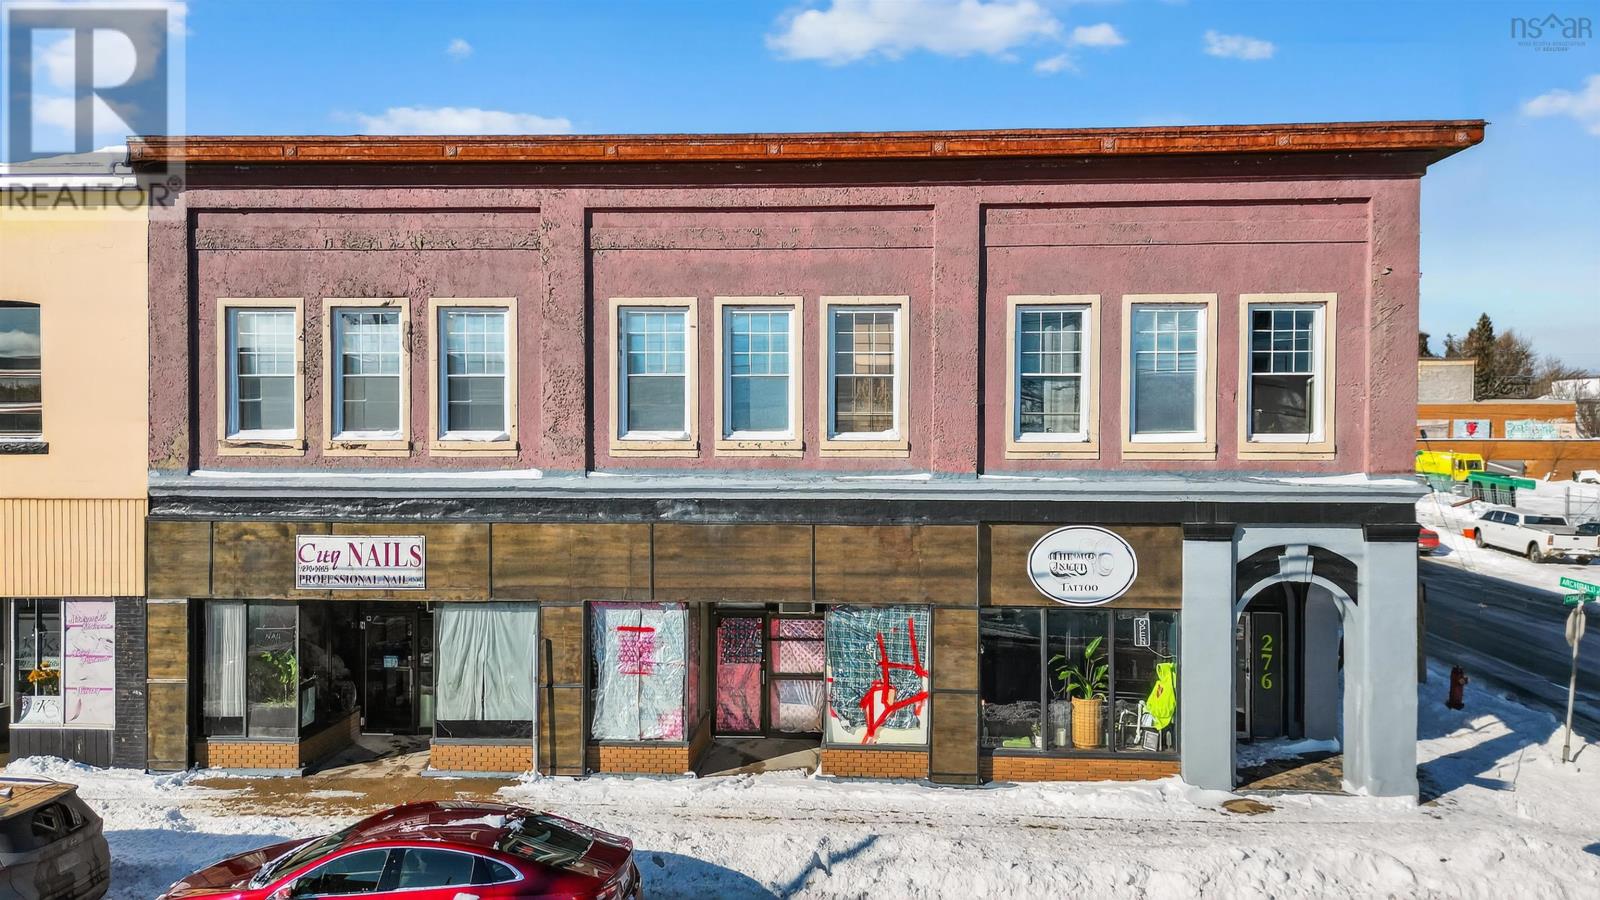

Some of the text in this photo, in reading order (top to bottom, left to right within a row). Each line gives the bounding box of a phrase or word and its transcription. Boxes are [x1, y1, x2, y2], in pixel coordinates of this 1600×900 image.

[347, 542, 422, 568] NAILS
[300, 574, 379, 585] PROFESSIONAL
[383, 574, 409, 585] NAIL
[1261, 634, 1273, 689] 276
